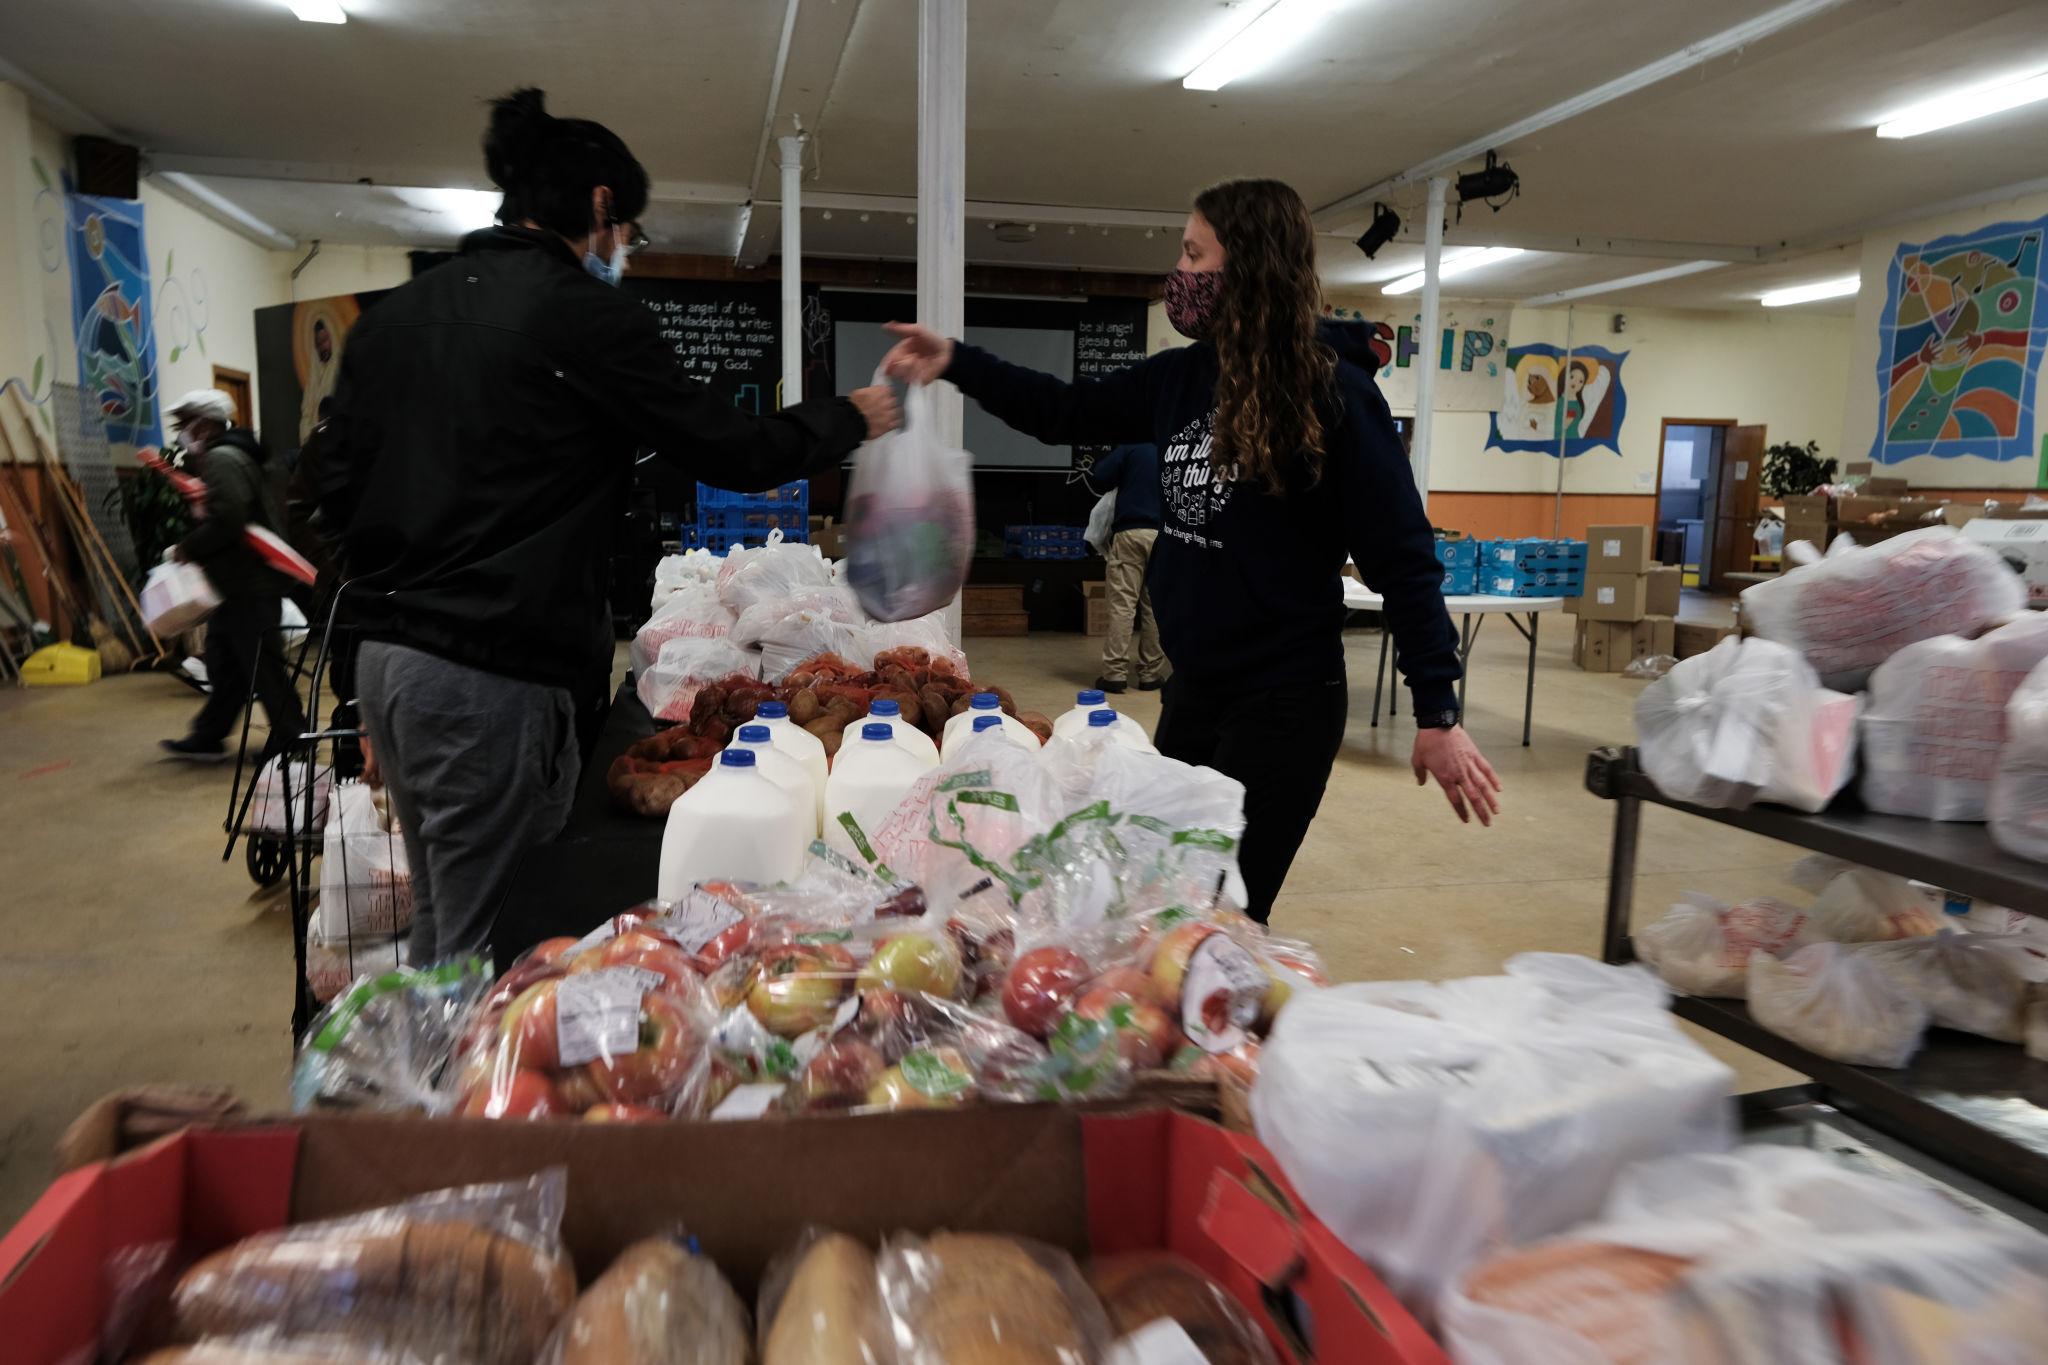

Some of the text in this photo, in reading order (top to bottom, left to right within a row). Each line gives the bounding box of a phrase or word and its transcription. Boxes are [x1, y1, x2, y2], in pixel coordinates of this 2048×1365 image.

[664, 300, 683, 313] the
[687, 300, 717, 316] angel
[722, 301, 734, 314] of
[738, 302, 757, 315] the
[671, 315, 735, 332] Philadelphia
[739, 318, 773, 330] write:
[685, 331, 700, 340] on
[702, 331, 722, 343] you
[725, 331, 742, 342] the
[746, 333, 775, 344] name
[688, 343, 710, 355] and
[711, 343, 731, 356] the
[734, 346, 763, 358] name
[683, 357, 753, 373] of my God.
[1173, 527, 1193, 544] change
